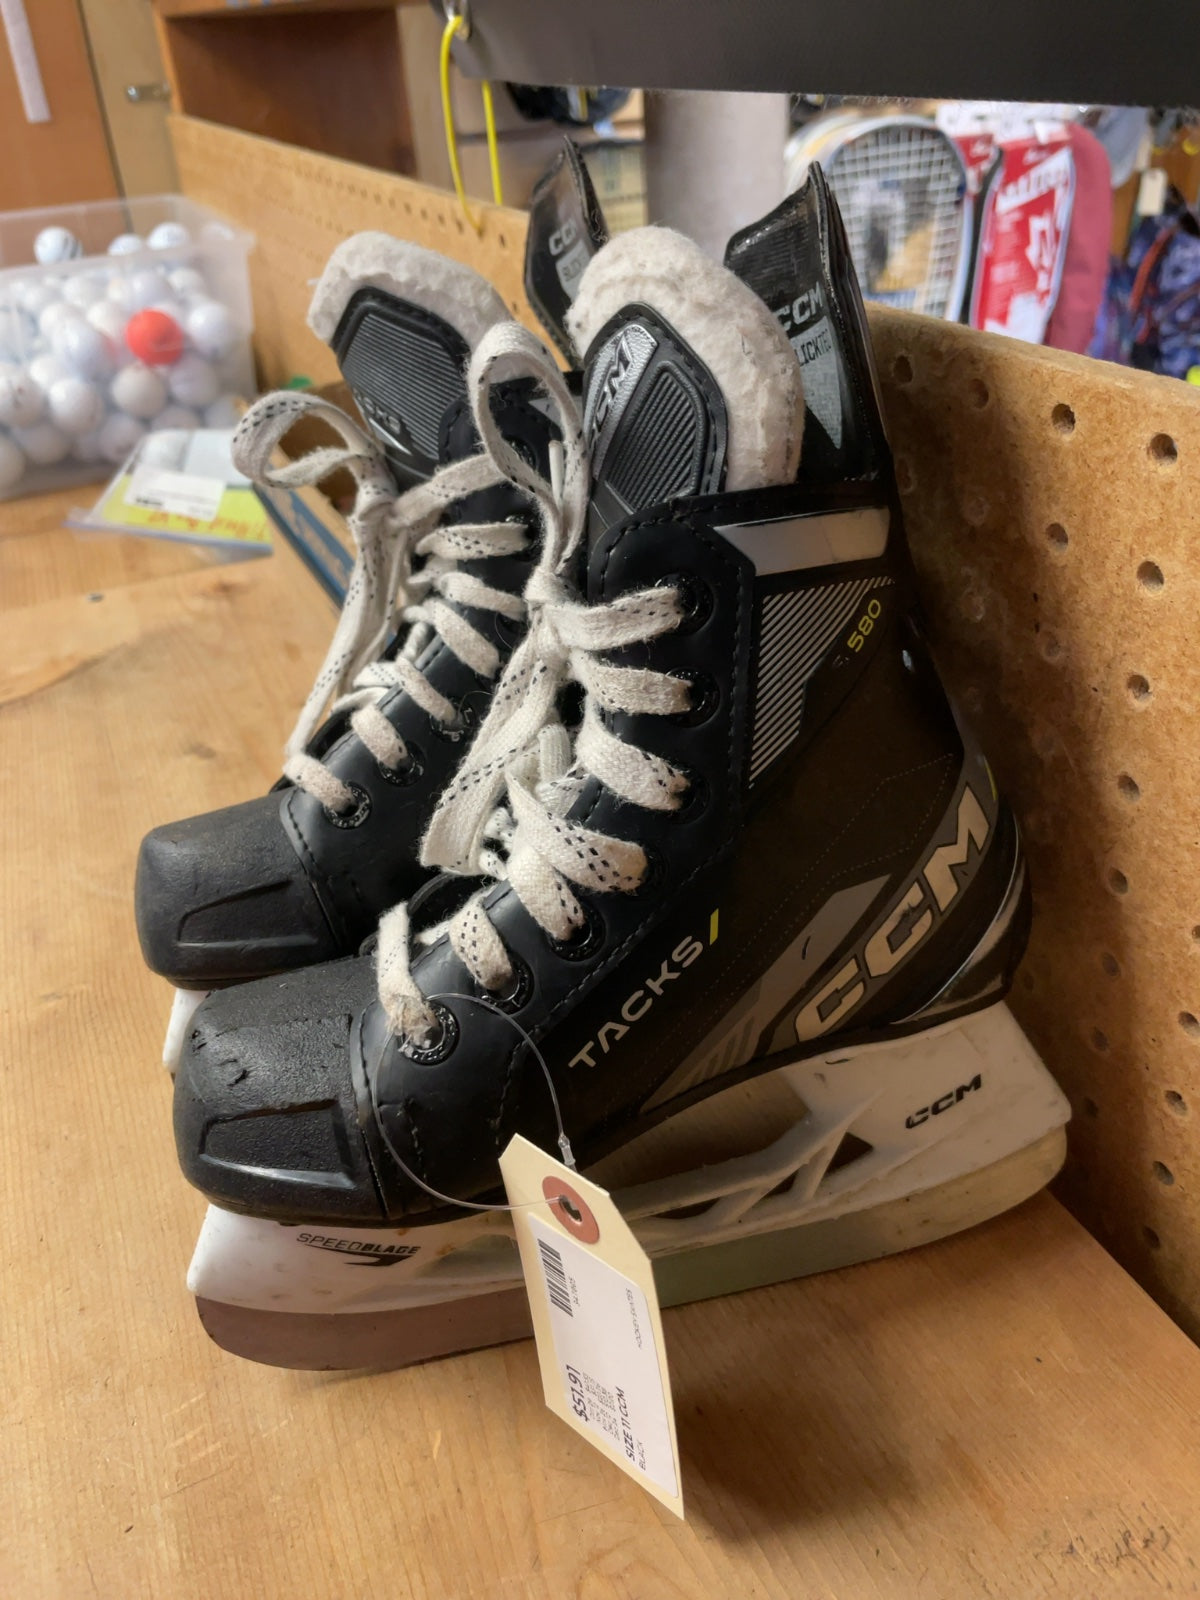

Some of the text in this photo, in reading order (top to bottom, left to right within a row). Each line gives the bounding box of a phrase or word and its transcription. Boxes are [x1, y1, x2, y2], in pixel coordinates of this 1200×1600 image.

[846, 599, 881, 653] 580
[795, 782, 990, 1042] CCM
[567, 935, 704, 1069] TACKS
[904, 1072, 982, 1130] CCM
[565, 1364, 589, 1423] $51.91
[615, 1385, 636, 1462] SIZE 11 CCM
[636, 1439, 646, 1471] BLACK
